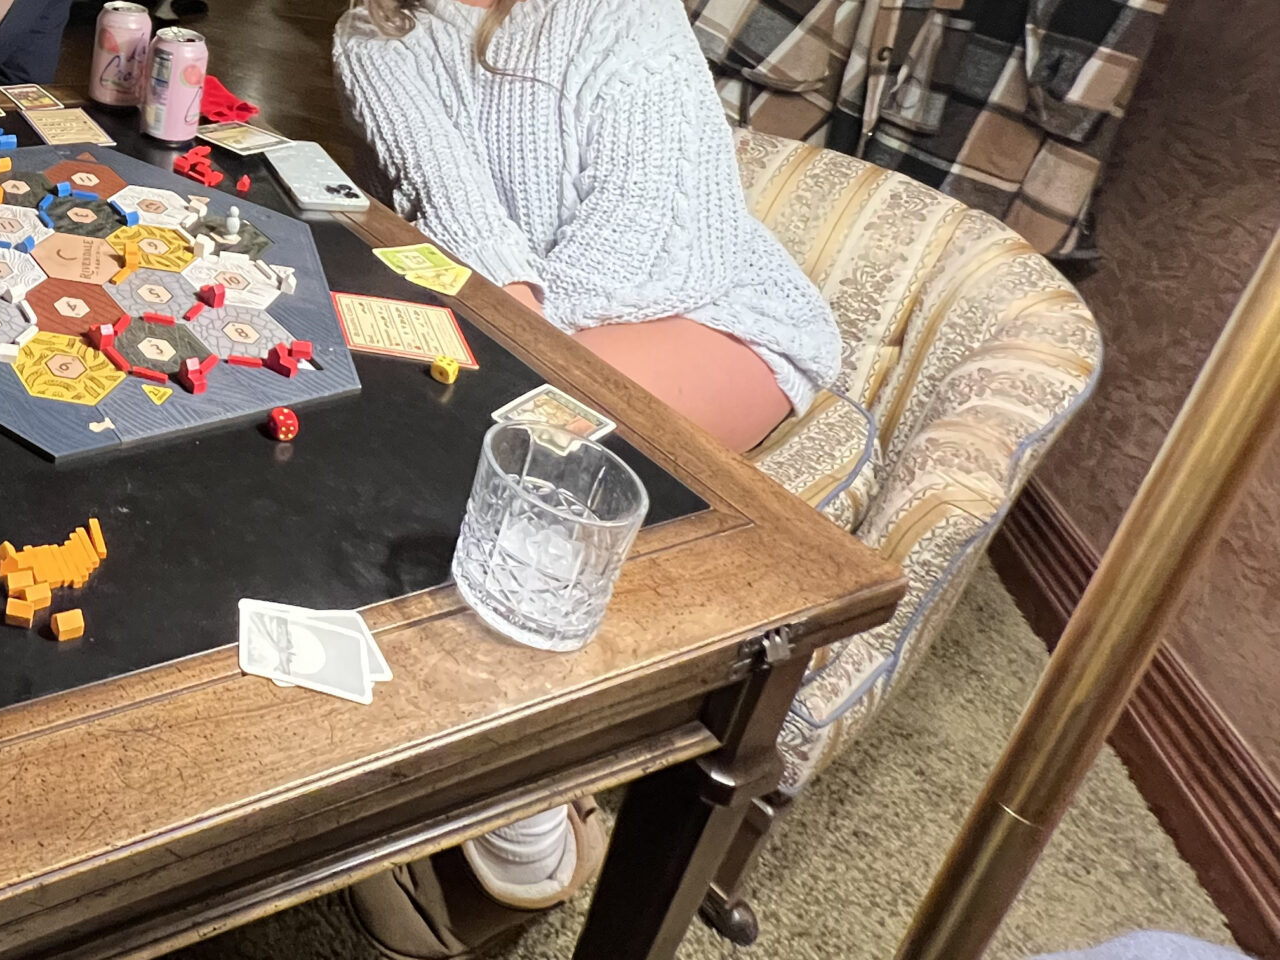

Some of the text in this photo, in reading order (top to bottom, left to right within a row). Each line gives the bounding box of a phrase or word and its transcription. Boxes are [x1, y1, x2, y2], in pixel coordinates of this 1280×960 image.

[223, 275, 241, 286] 10
[147, 287, 161, 299] 5
[234, 327, 249, 338] 8
[150, 343, 163, 355] 3
